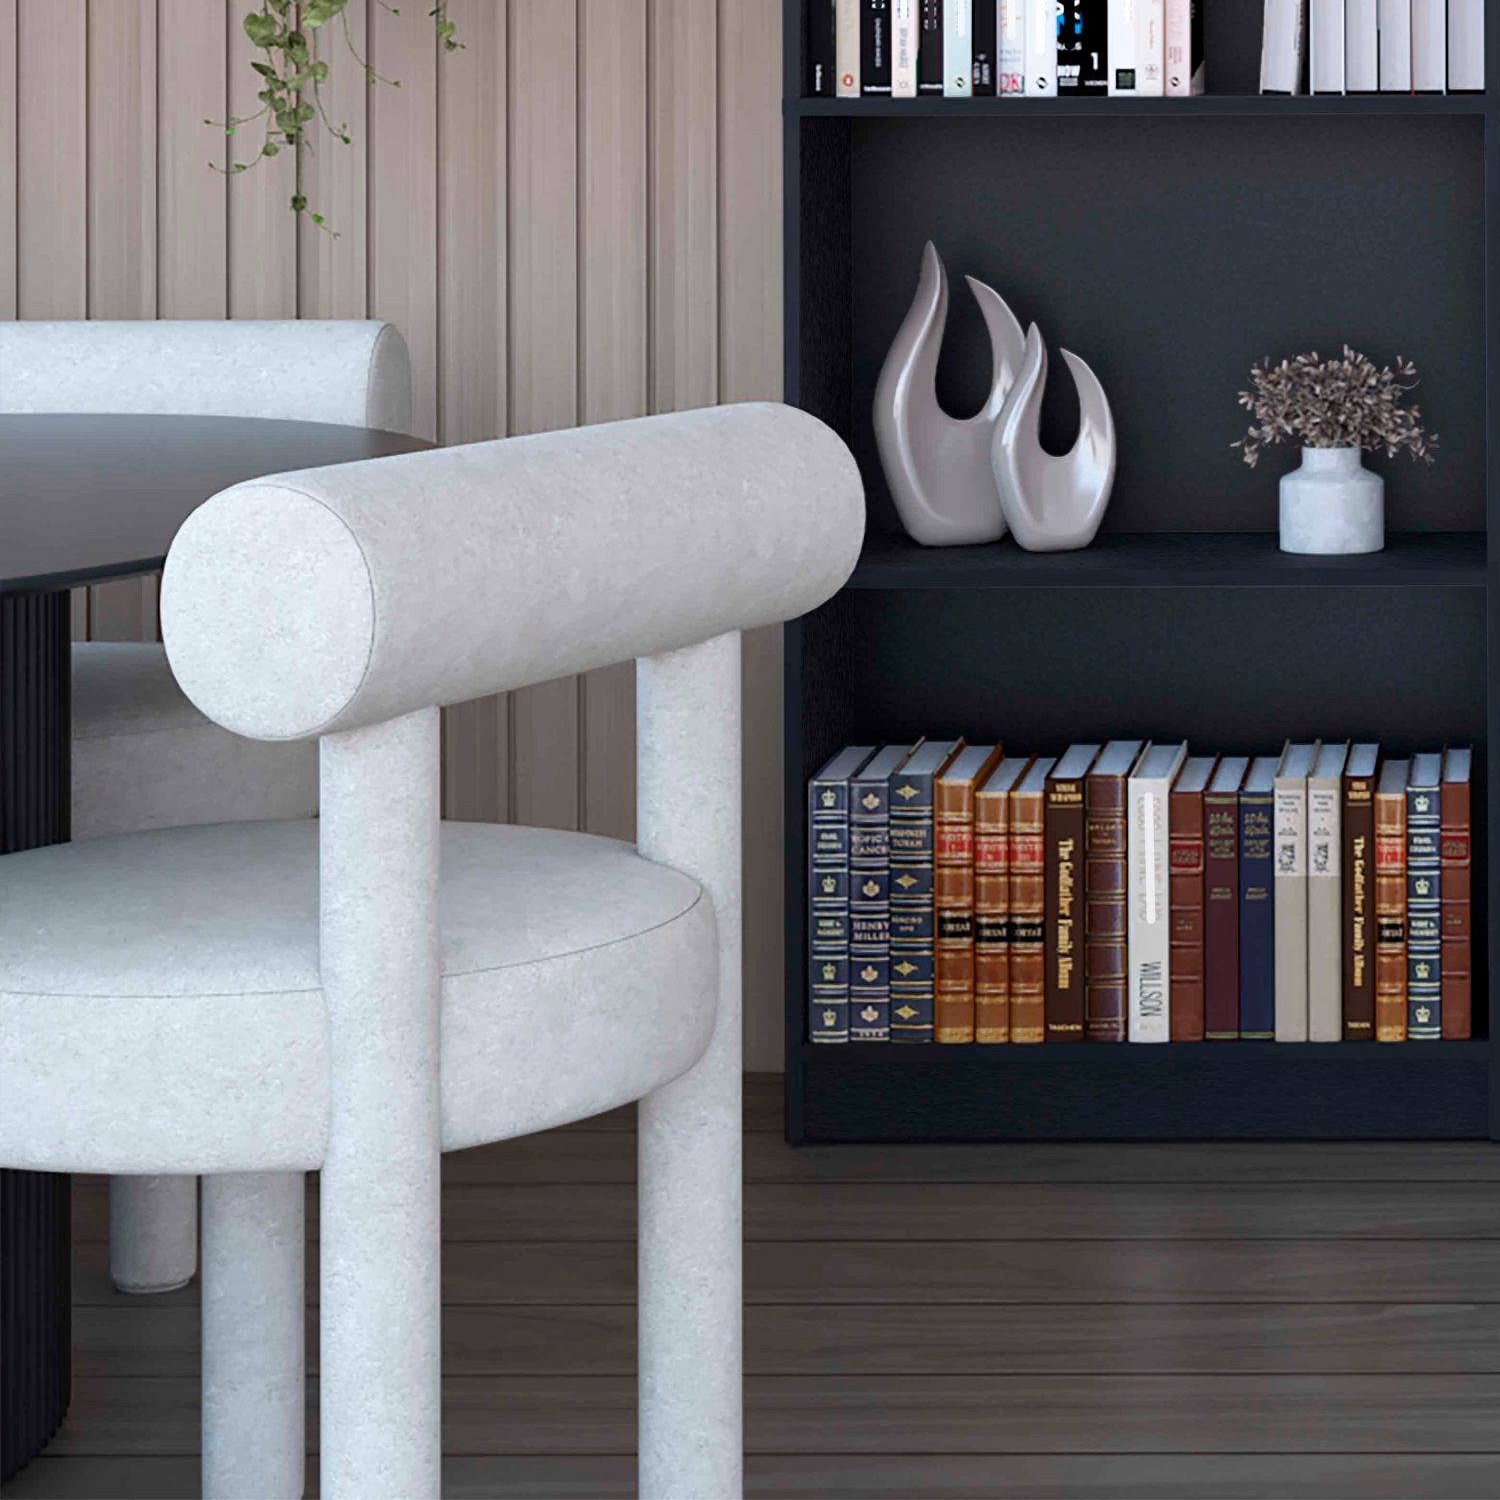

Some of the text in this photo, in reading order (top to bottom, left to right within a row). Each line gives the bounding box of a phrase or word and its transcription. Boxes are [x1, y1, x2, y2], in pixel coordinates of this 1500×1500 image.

[1000, 73, 1020, 91] DK
[1353, 836, 1364, 858] The
[1353, 859, 1365, 914] Godfather
[1056, 838, 1074, 989] The Godfather Family Album
[1352, 916, 1364, 952] Family
